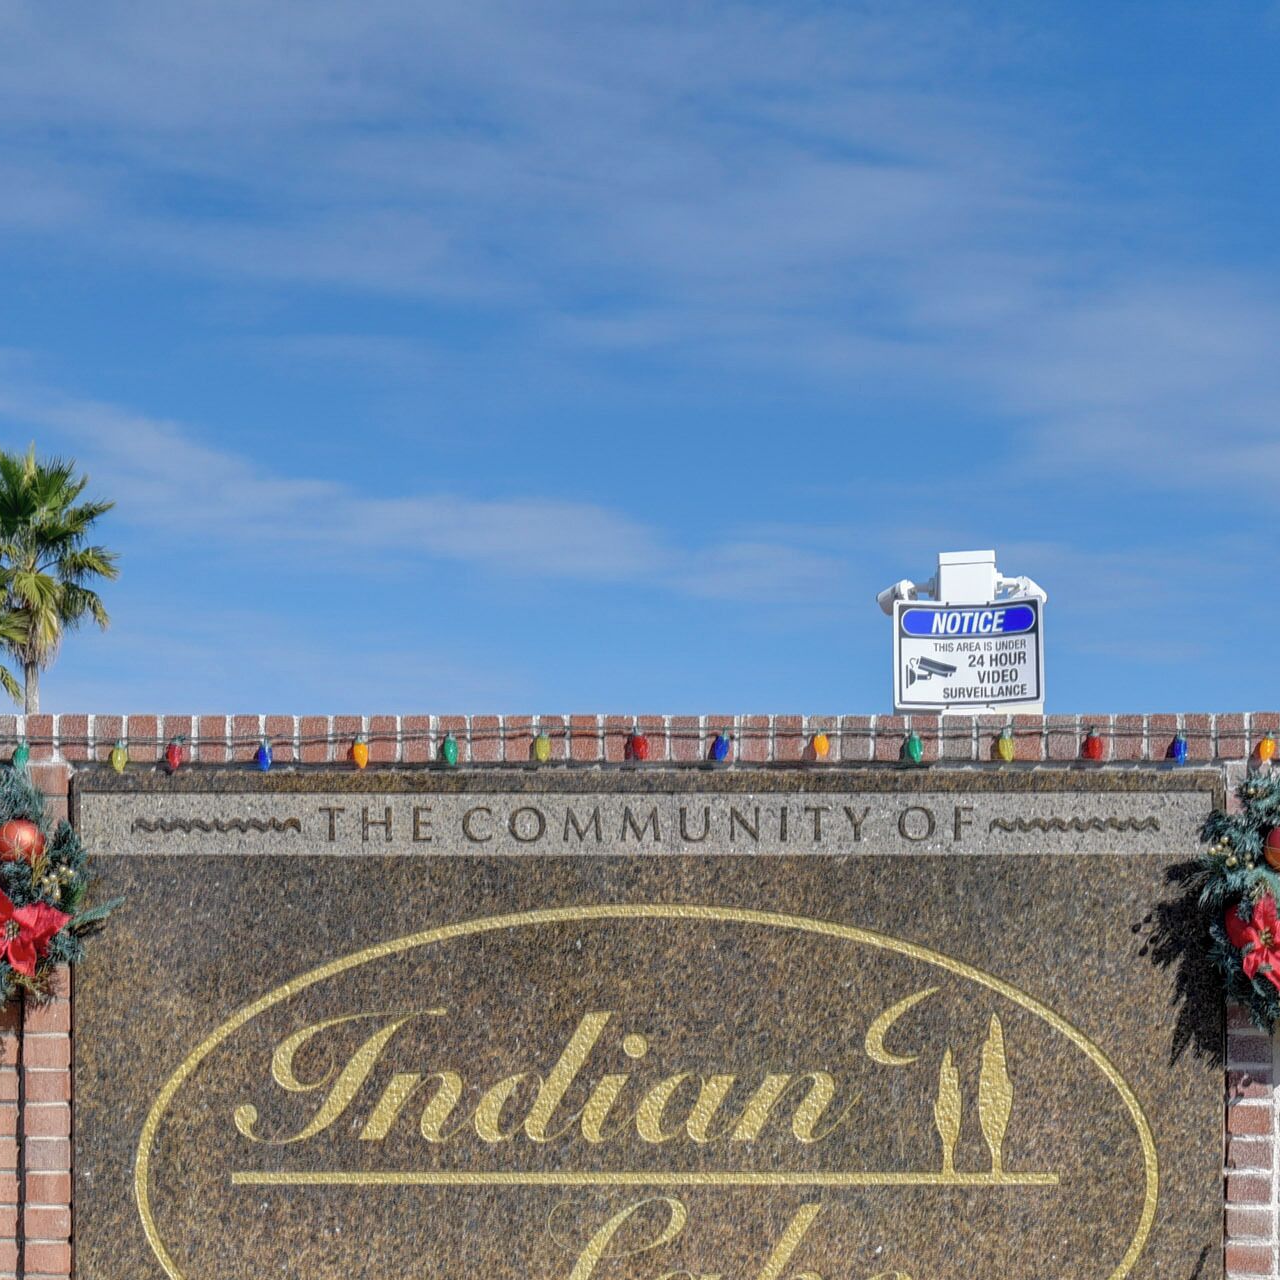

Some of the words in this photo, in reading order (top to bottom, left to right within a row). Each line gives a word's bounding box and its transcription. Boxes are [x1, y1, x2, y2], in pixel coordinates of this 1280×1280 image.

[931, 611, 1006, 634] NOTICE
[933, 643, 954, 653] THIS
[956, 641, 981, 652] AREA
[983, 641, 992, 651] IS
[995, 639, 1026, 651] UNDER
[968, 655, 985, 668] 24
[989, 651, 1027, 667] HOUR
[977, 668, 1019, 684] VIDEO
[942, 683, 1027, 699] SURVEILLANCE
[320, 806, 433, 843] THE
[462, 804, 872, 844] COMMUNITY
[897, 804, 975, 844] OF
[233, 1009, 862, 1144] Indian
